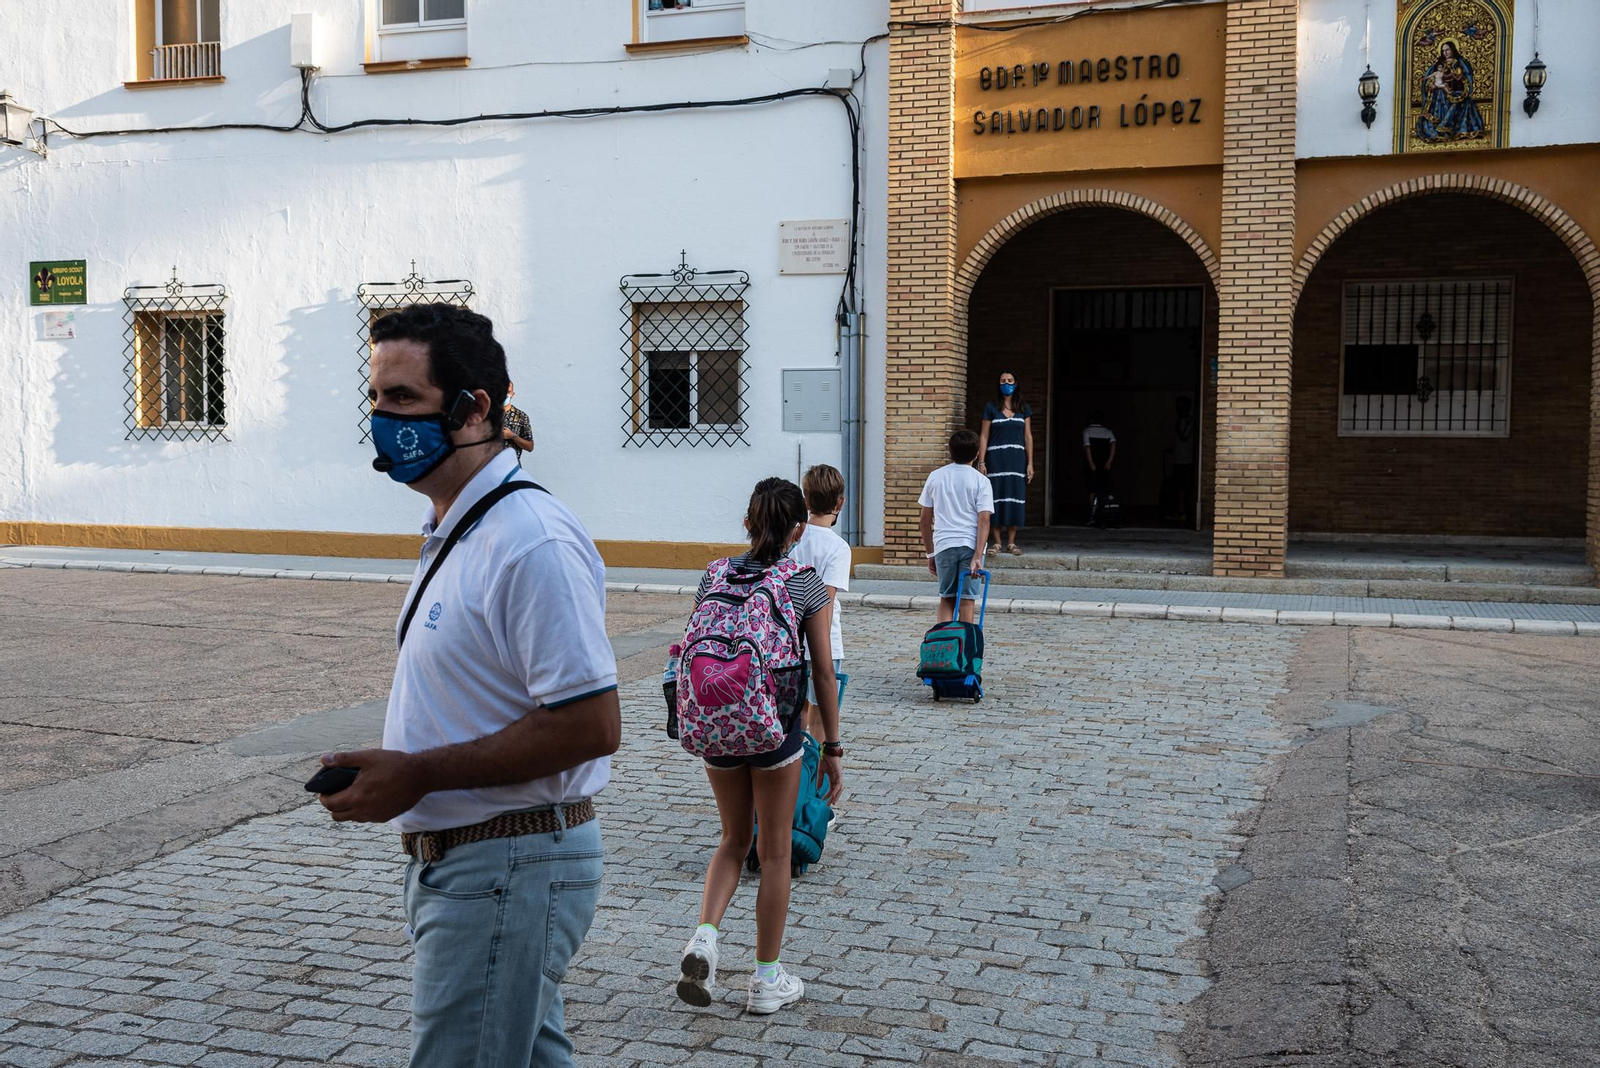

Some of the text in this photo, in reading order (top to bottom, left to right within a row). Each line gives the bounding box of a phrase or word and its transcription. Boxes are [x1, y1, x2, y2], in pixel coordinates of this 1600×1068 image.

[973, 105, 1101, 135] SALVADOR
[56, 276, 83, 286] LOYOLA
[403, 449, 424, 460] SAFA
